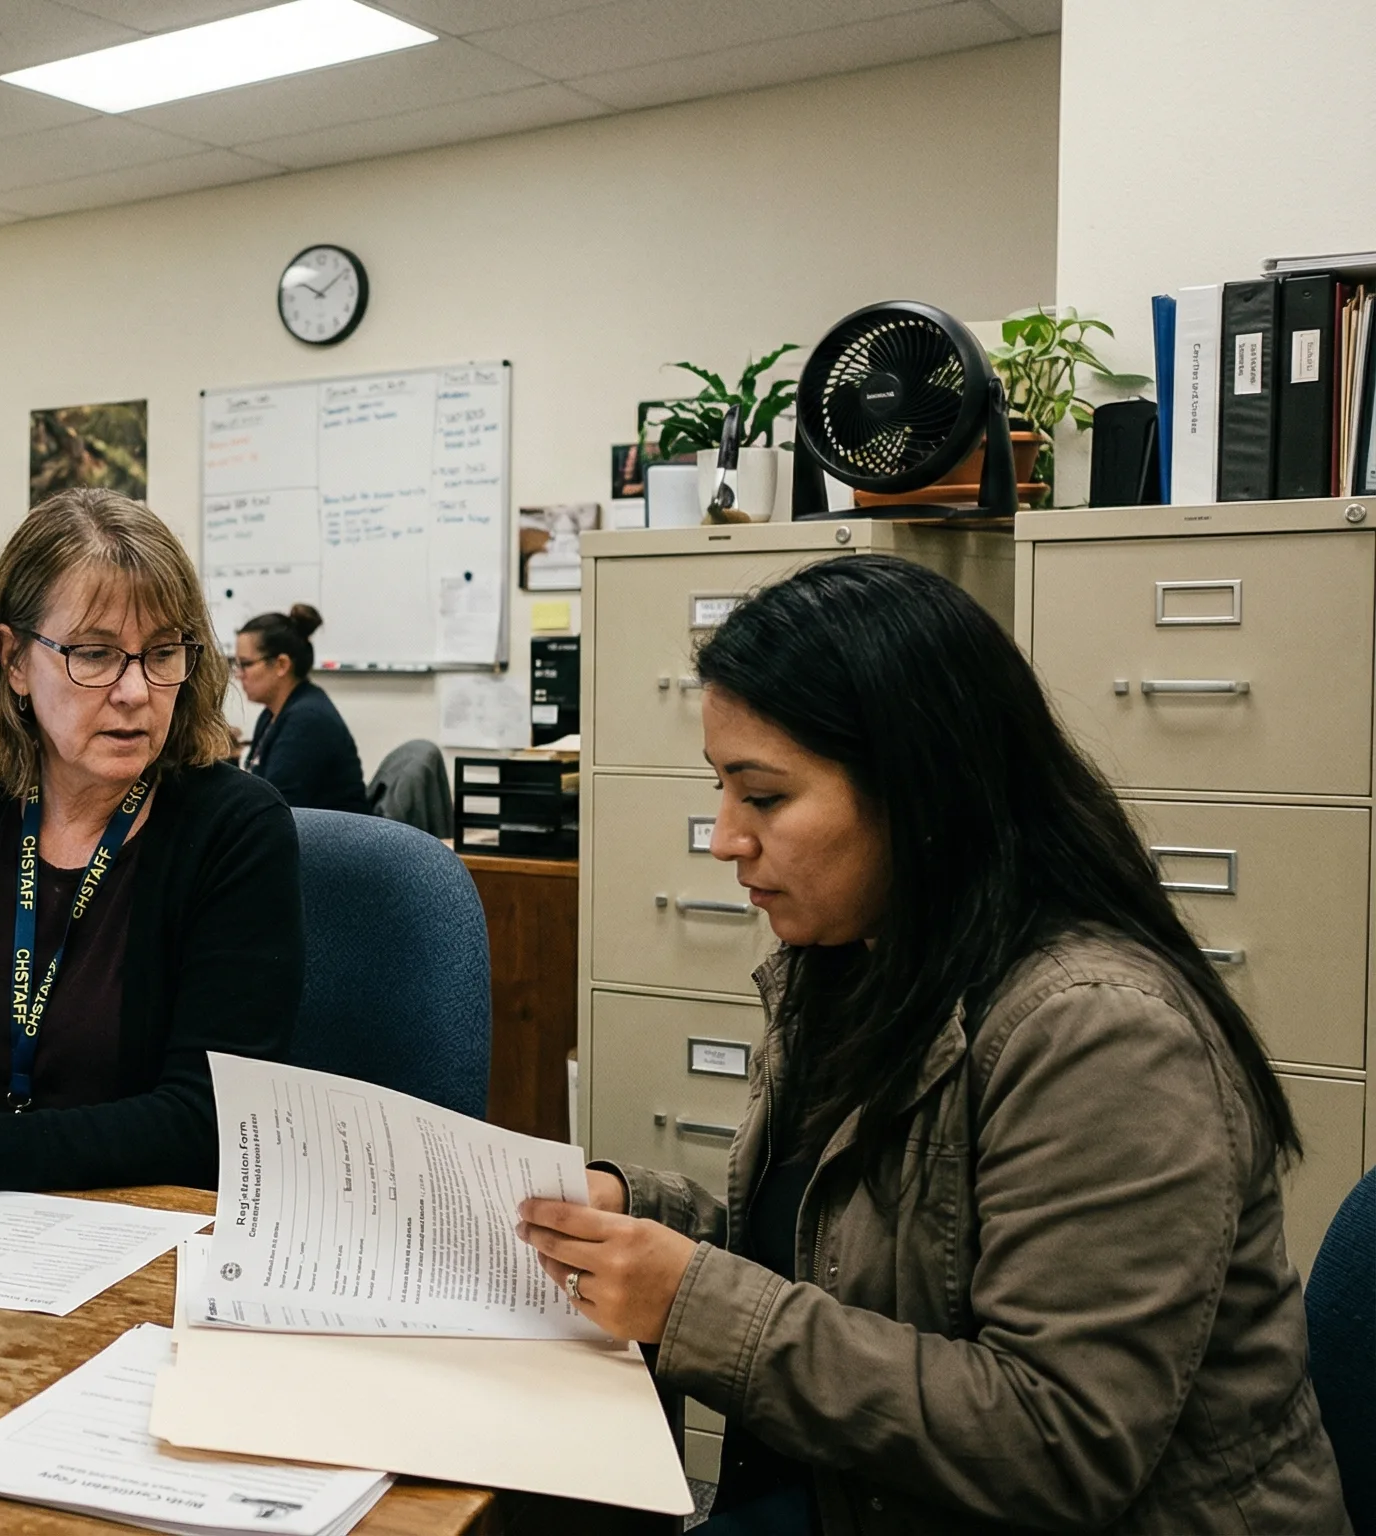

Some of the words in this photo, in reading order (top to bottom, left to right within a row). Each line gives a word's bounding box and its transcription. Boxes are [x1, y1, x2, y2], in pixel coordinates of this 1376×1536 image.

[20, 835, 36, 910] CHSTAFF
[73, 846, 112, 919] CHSTAFF
[13, 948, 30, 1025] CHSTAFF
